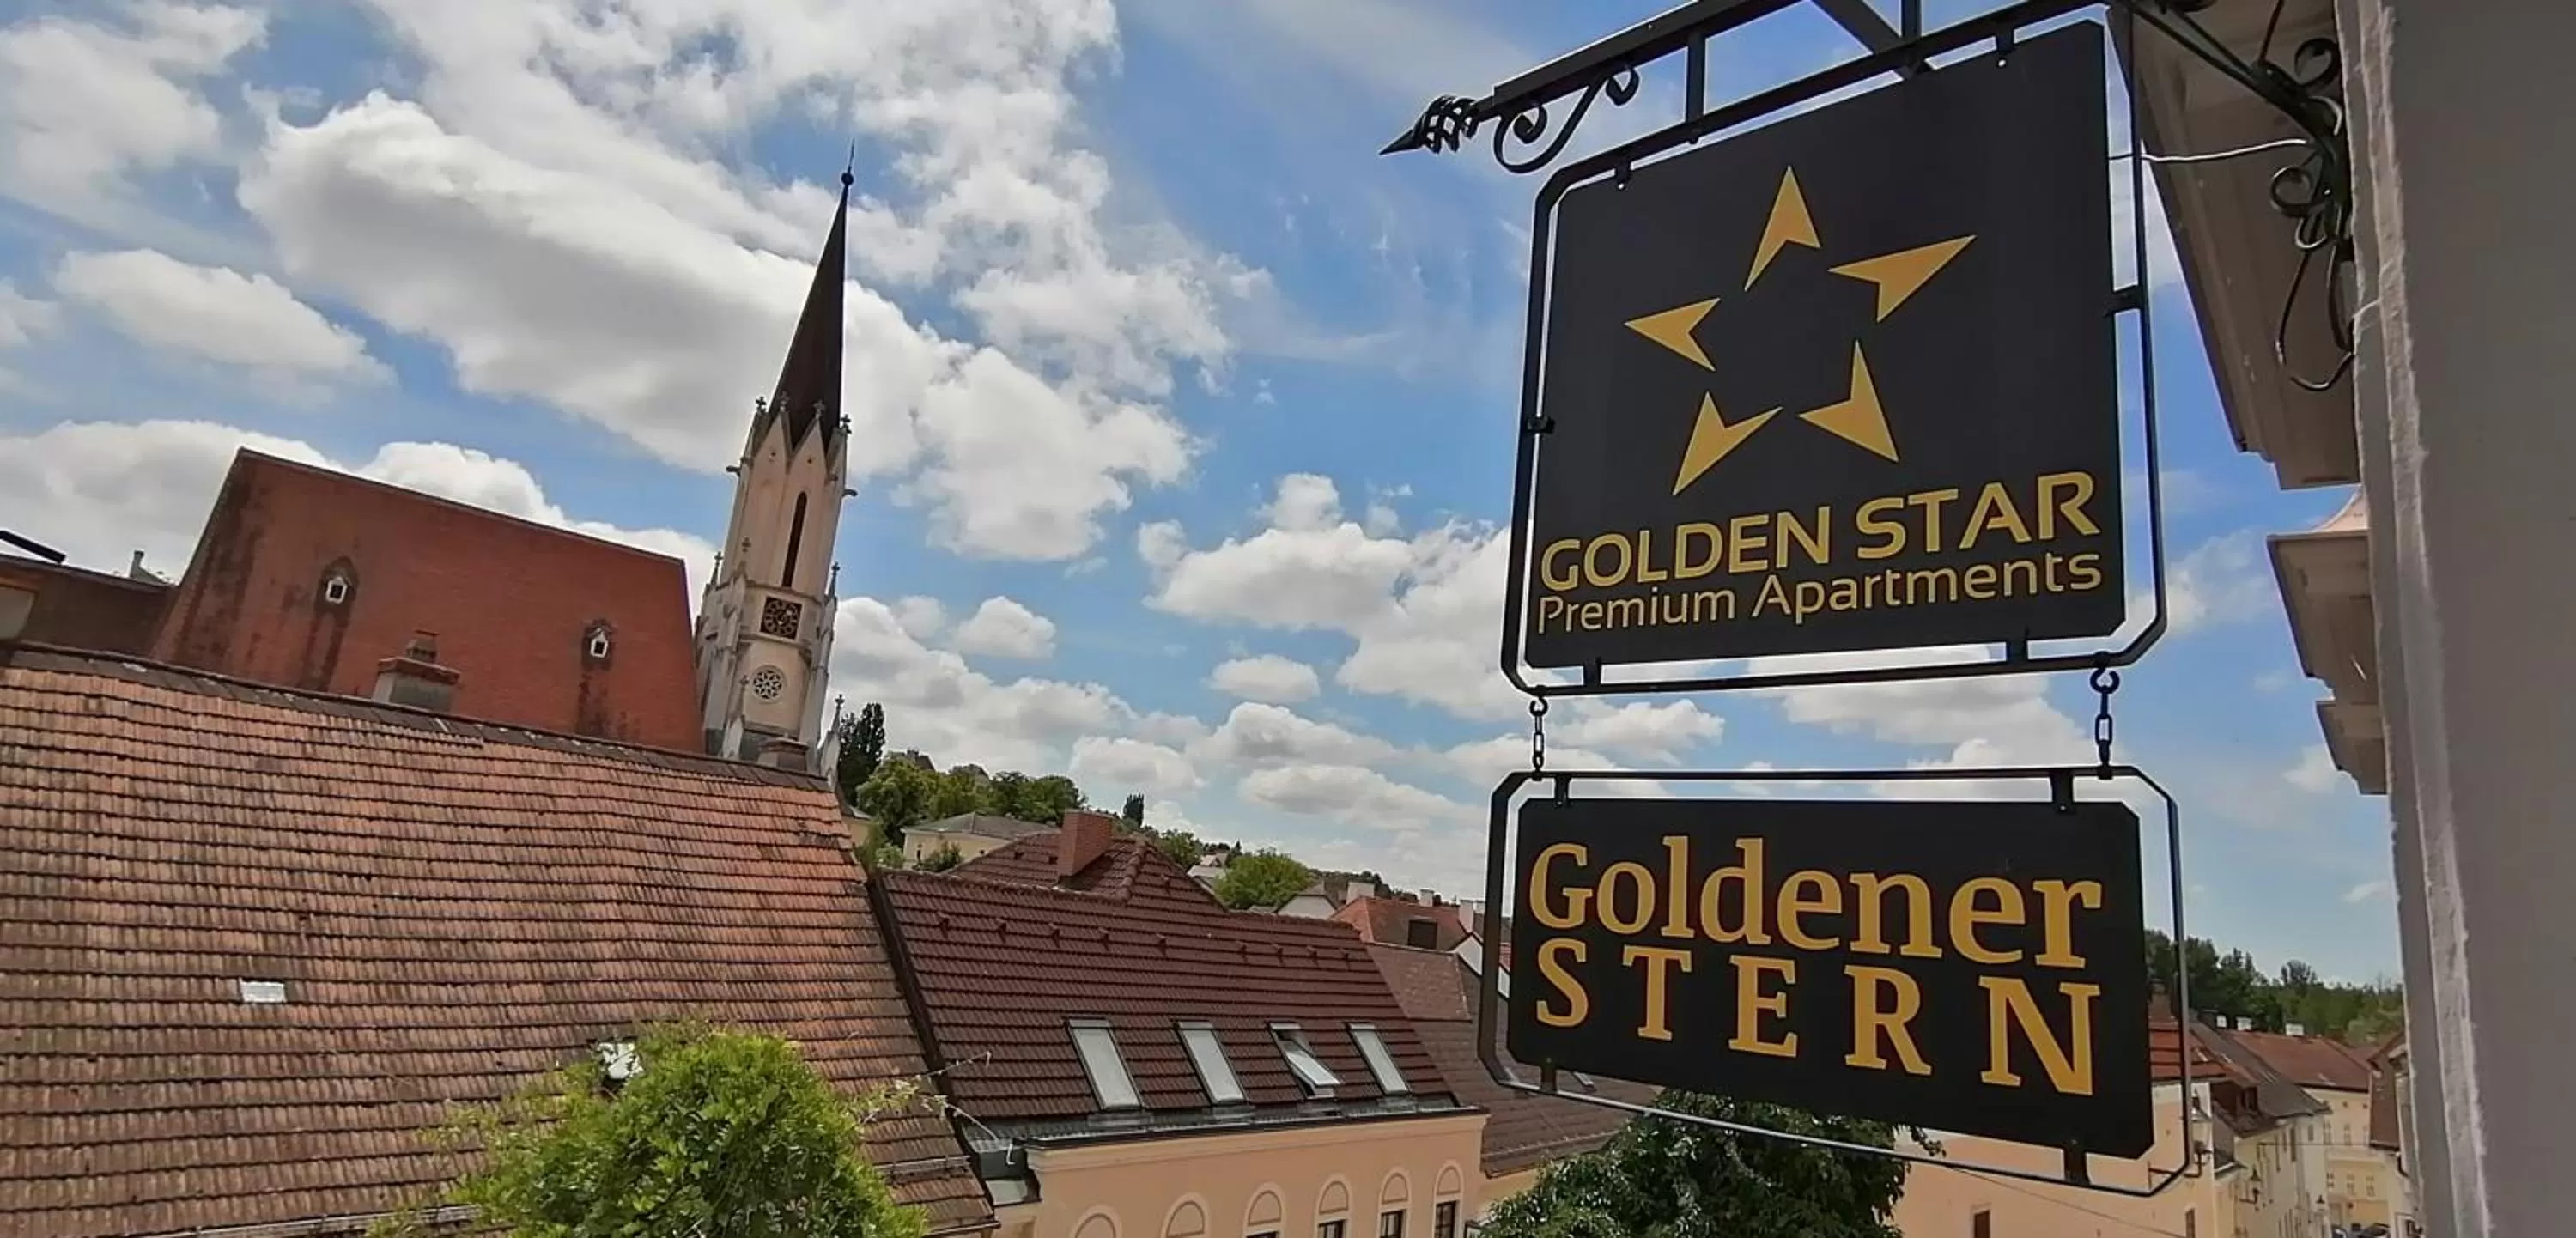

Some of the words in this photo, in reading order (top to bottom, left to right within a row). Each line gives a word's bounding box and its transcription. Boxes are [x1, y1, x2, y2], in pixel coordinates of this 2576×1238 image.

[1537, 586, 1735, 635] Premium
[1752, 551, 2103, 624] Apartments
[1541, 506, 1831, 592] GOLDEN
[1856, 470, 2101, 561] STAR
[1528, 835, 2103, 969] Goldener
[1535, 937, 2101, 1097] STERN
